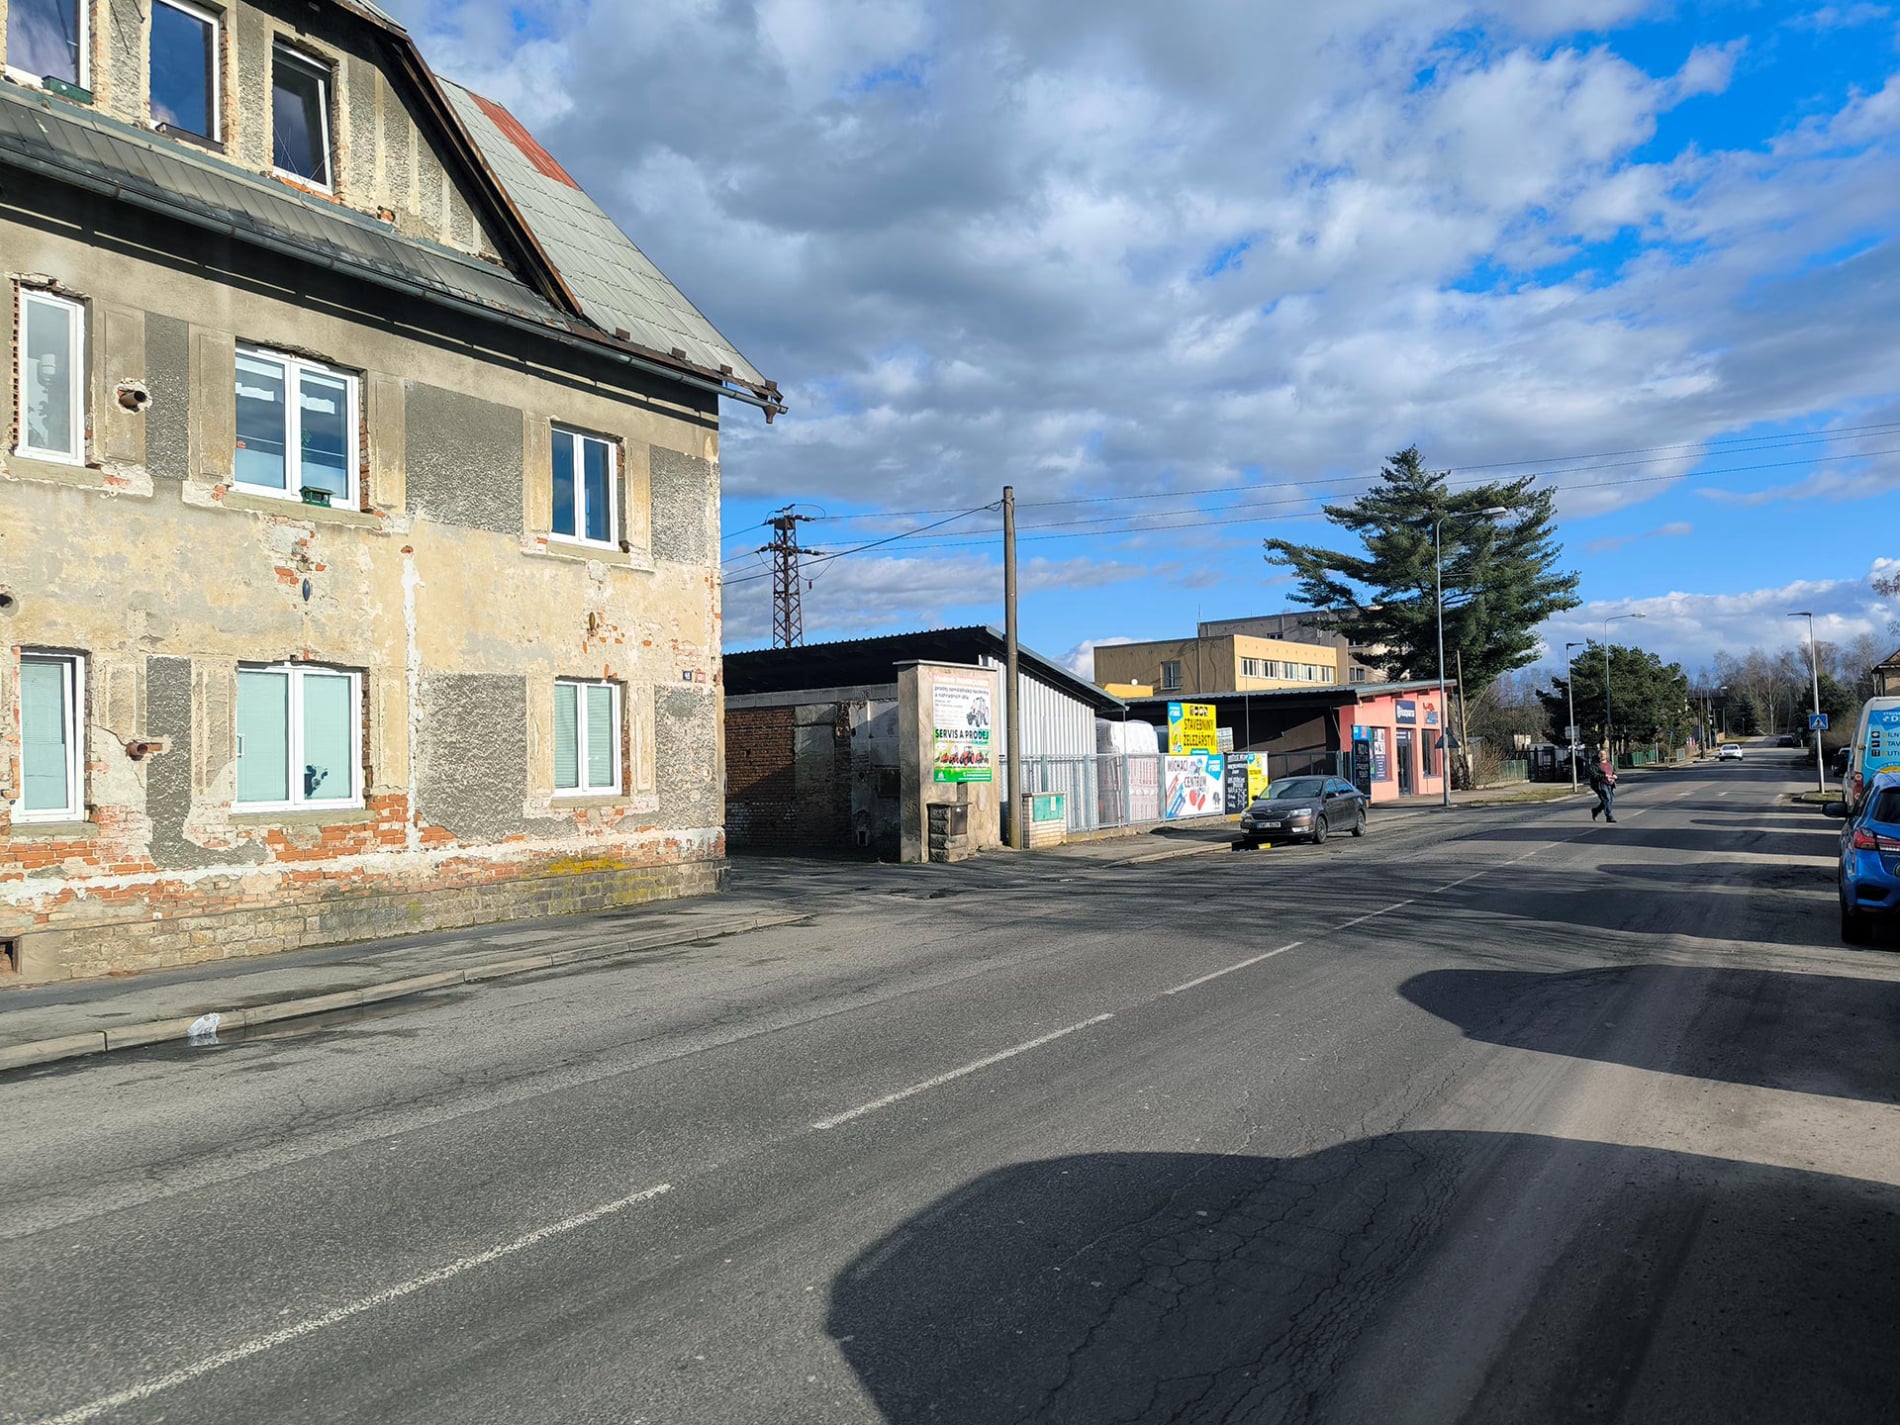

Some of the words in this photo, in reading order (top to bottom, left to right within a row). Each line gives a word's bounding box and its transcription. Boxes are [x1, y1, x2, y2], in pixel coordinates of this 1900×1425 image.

[1184, 718, 1214, 731] STAVEBNINY
[935, 729, 958, 739] SERVIS
[960, 730, 964, 738] A
[965, 730, 989, 740] PRODEJ
